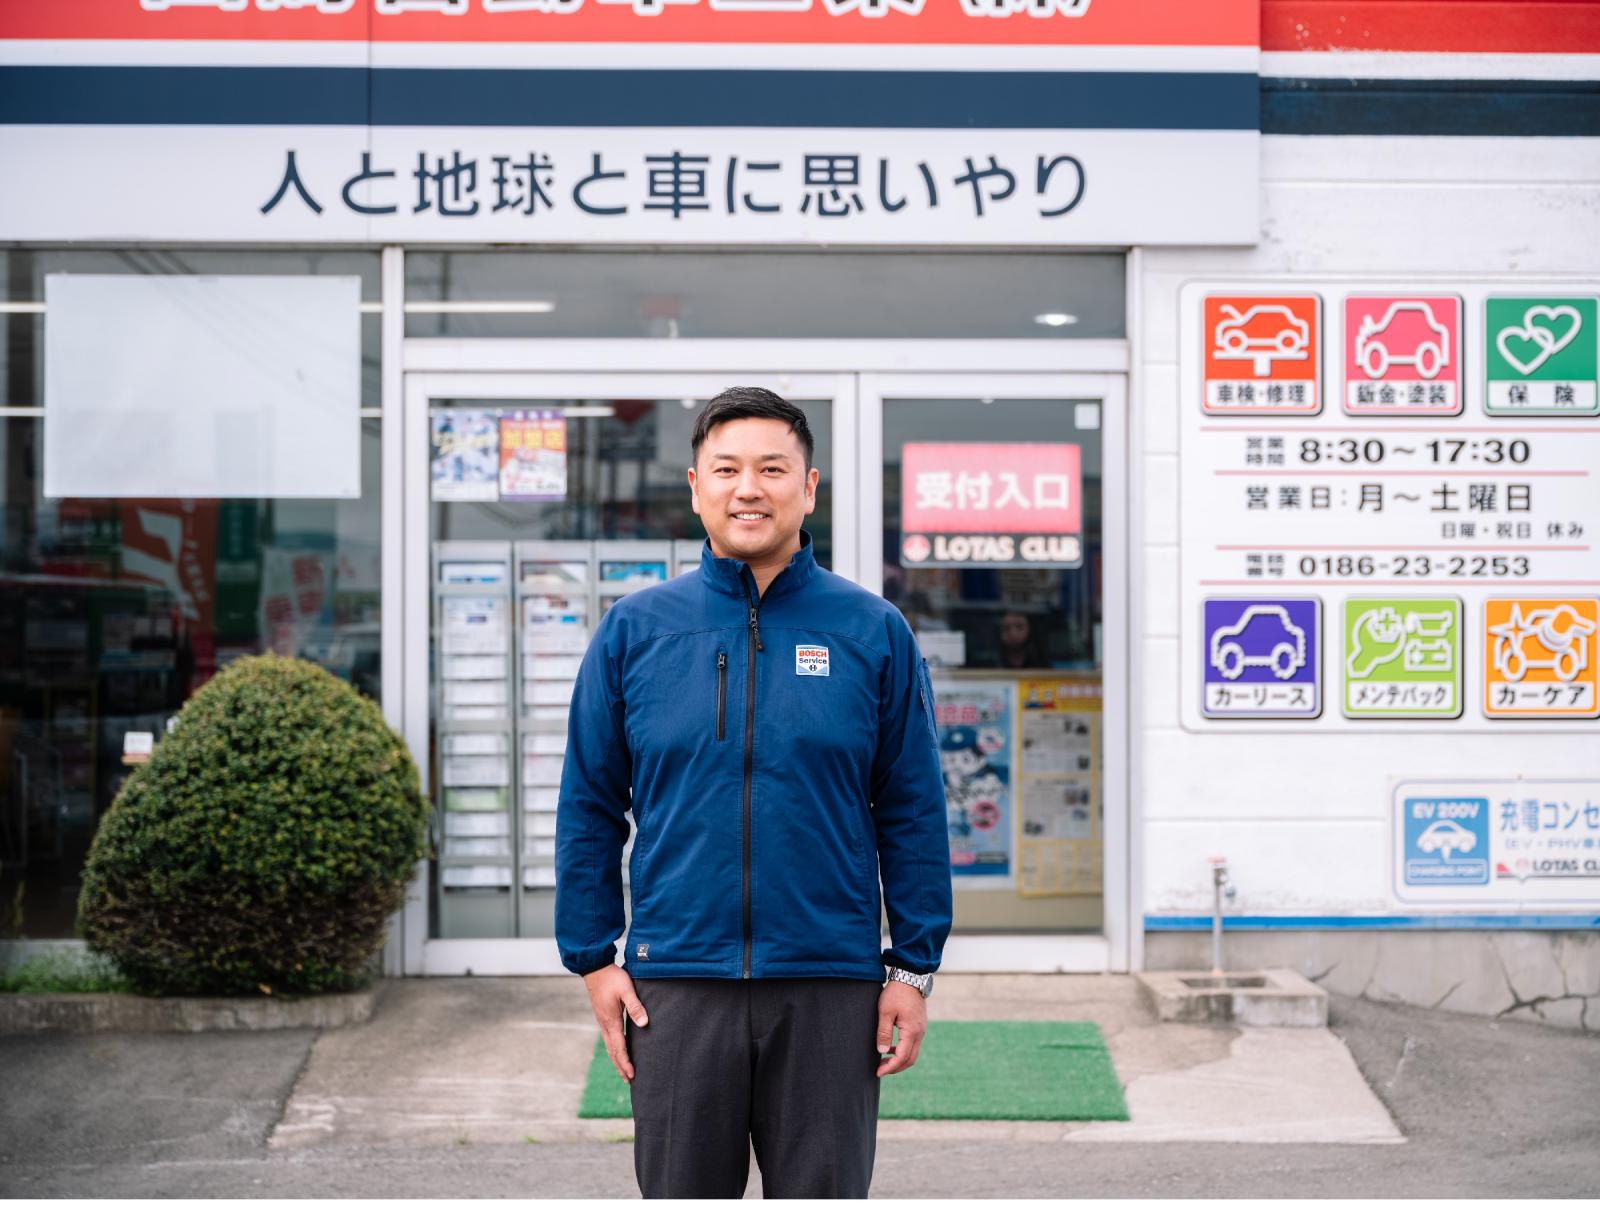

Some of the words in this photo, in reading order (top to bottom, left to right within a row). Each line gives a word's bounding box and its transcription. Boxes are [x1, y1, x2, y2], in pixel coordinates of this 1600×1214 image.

[259, 149, 1087, 220] 人と地球と車に思いやり
[915, 471, 1070, 511] 受付入口
[1546, 522, 1584, 538] 休み
[934, 536, 1015, 561] LOTAS
[1020, 536, 1080, 562] CLUB
[1299, 556, 1531, 577] 0186-23-2253
[1213, 685, 1307, 706] カーリース
[1497, 685, 1587, 706] カーケア
[1532, 859, 1579, 873] LOTAS
